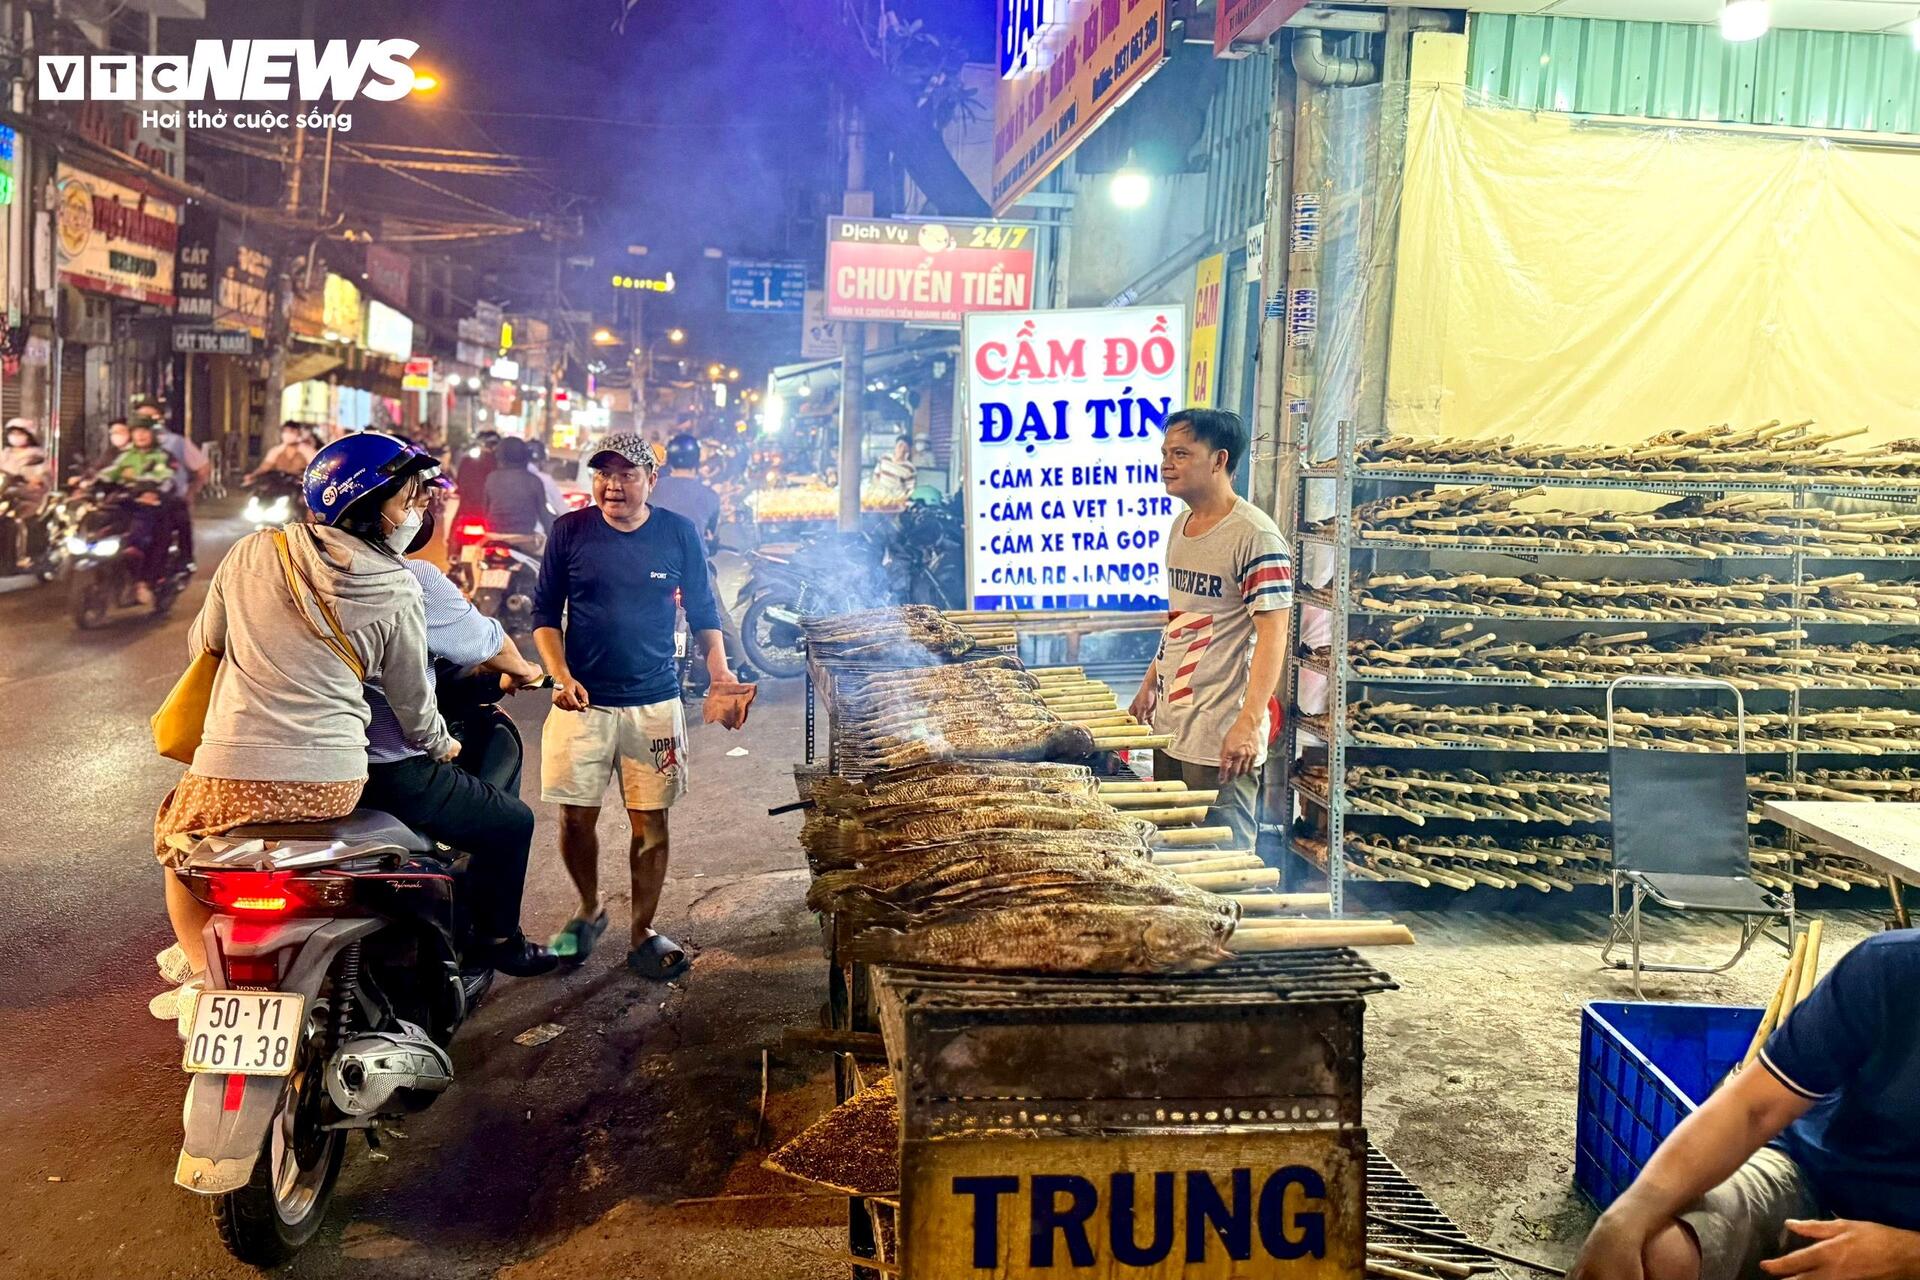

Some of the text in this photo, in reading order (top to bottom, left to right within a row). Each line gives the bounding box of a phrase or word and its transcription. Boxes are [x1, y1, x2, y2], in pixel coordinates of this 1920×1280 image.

[841, 224, 1028, 249] Dịch Vụ 24/7
[837, 256, 952, 303] CHUYỂN
[961, 262, 1025, 306] TIỀN
[178, 297, 212, 315] NAM
[220, 335, 246, 350] NAM
[975, 315, 1175, 380] CẦM ĐỒ
[979, 387, 1172, 453] ĐẠI TÍN
[1041, 467, 1063, 486] XE
[1041, 534, 1064, 552] XE
[209, 997, 283, 1031] 50-Y1
[193, 1033, 289, 1068] 061.38
[952, 1164, 1327, 1268] TRUNG
